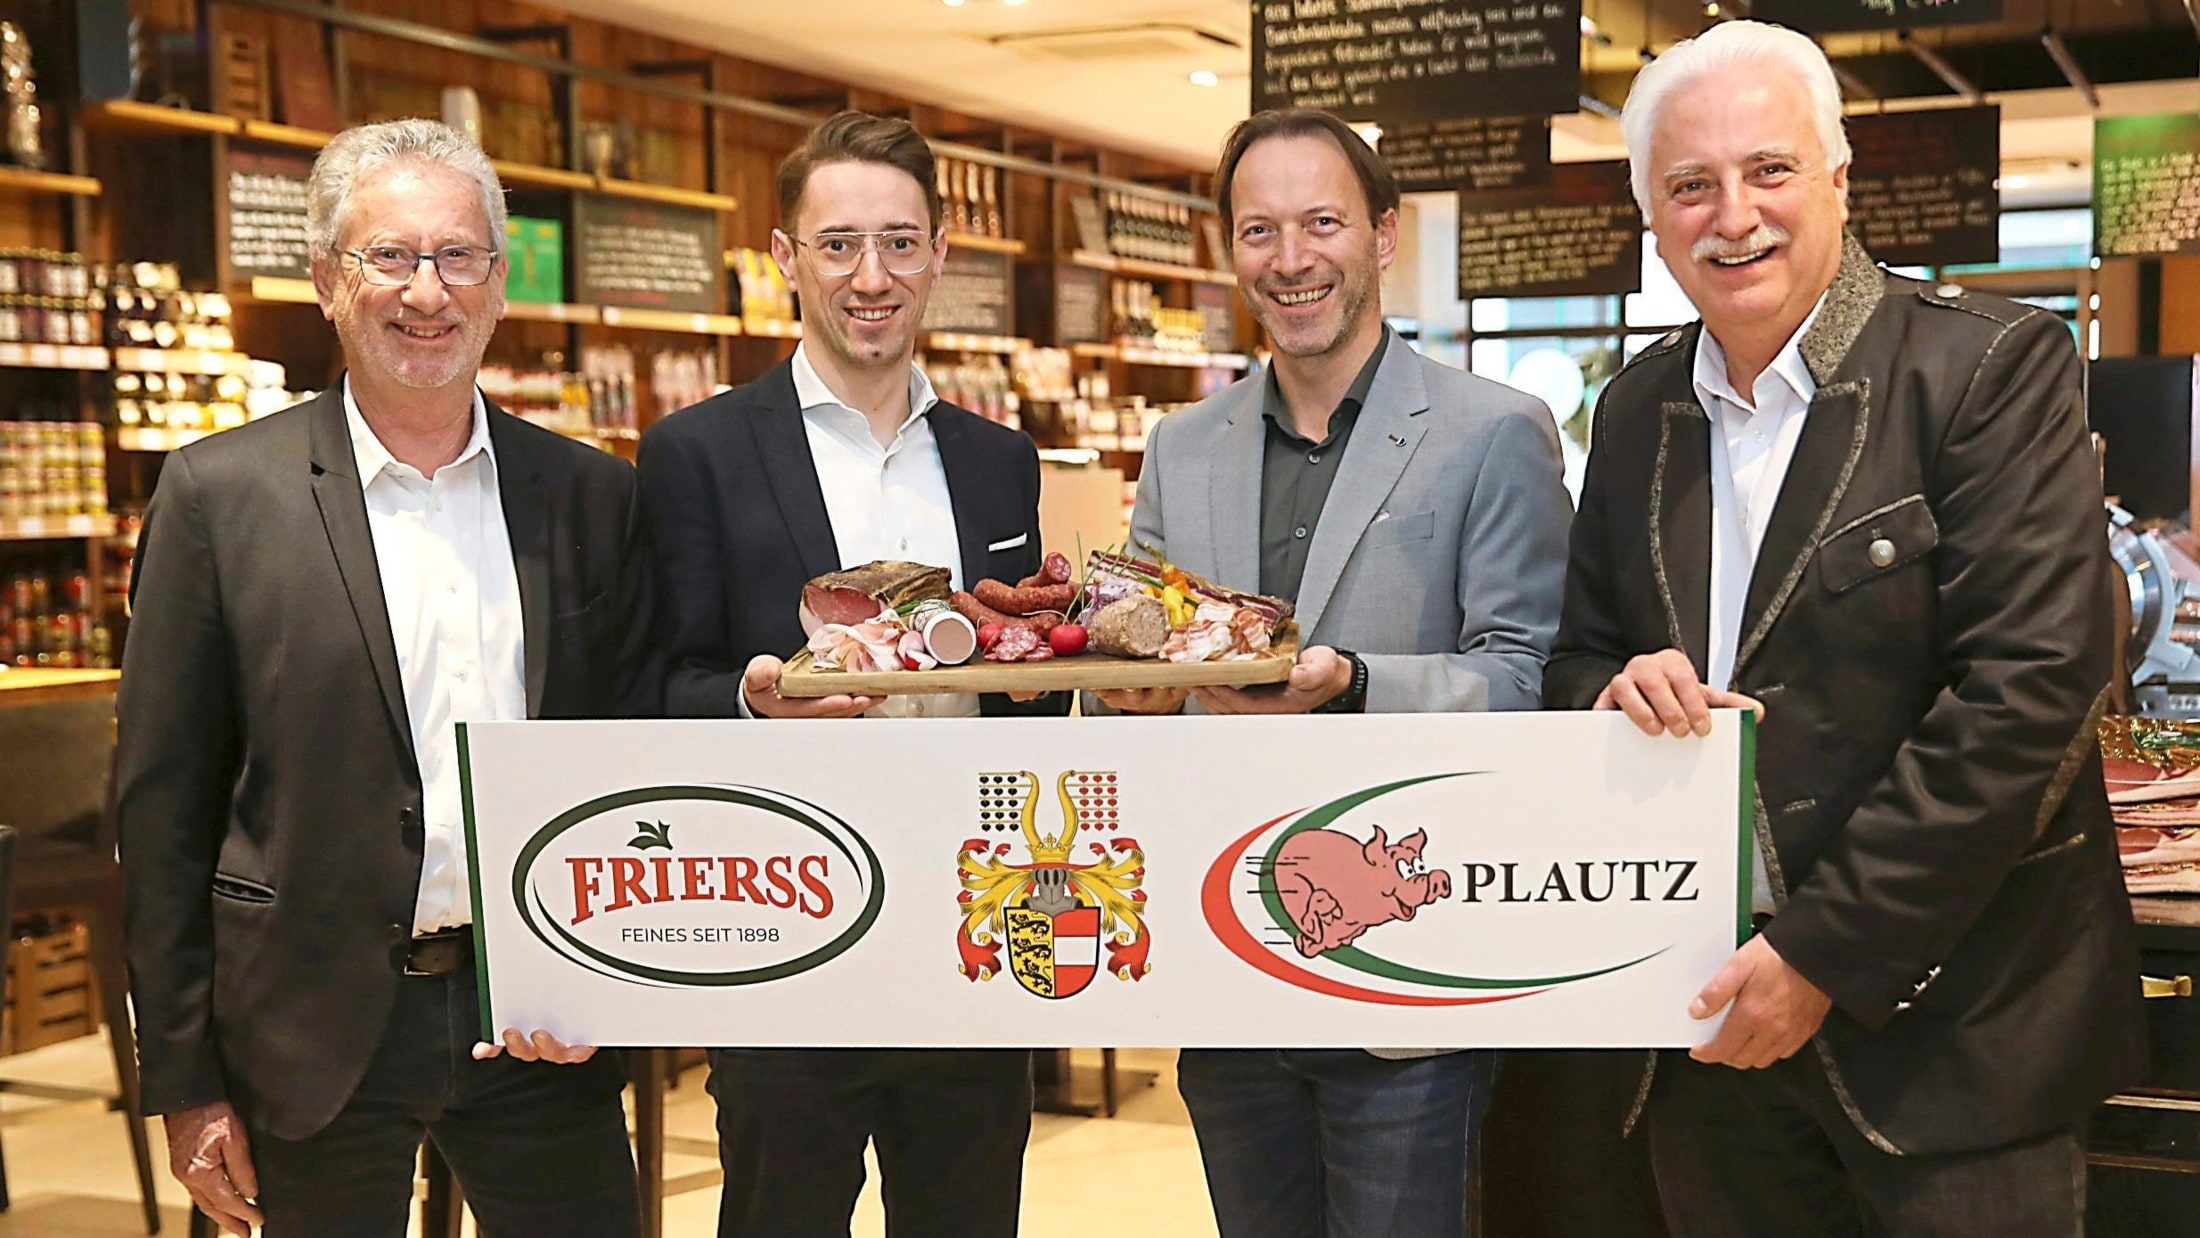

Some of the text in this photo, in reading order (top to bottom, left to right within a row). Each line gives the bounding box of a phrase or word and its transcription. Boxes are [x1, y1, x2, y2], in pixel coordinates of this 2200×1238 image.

[566, 855, 834, 925] FRIERSS
[1462, 860, 1700, 903] PLAUTZ
[621, 927, 780, 943] FEINES SEIT 1898
